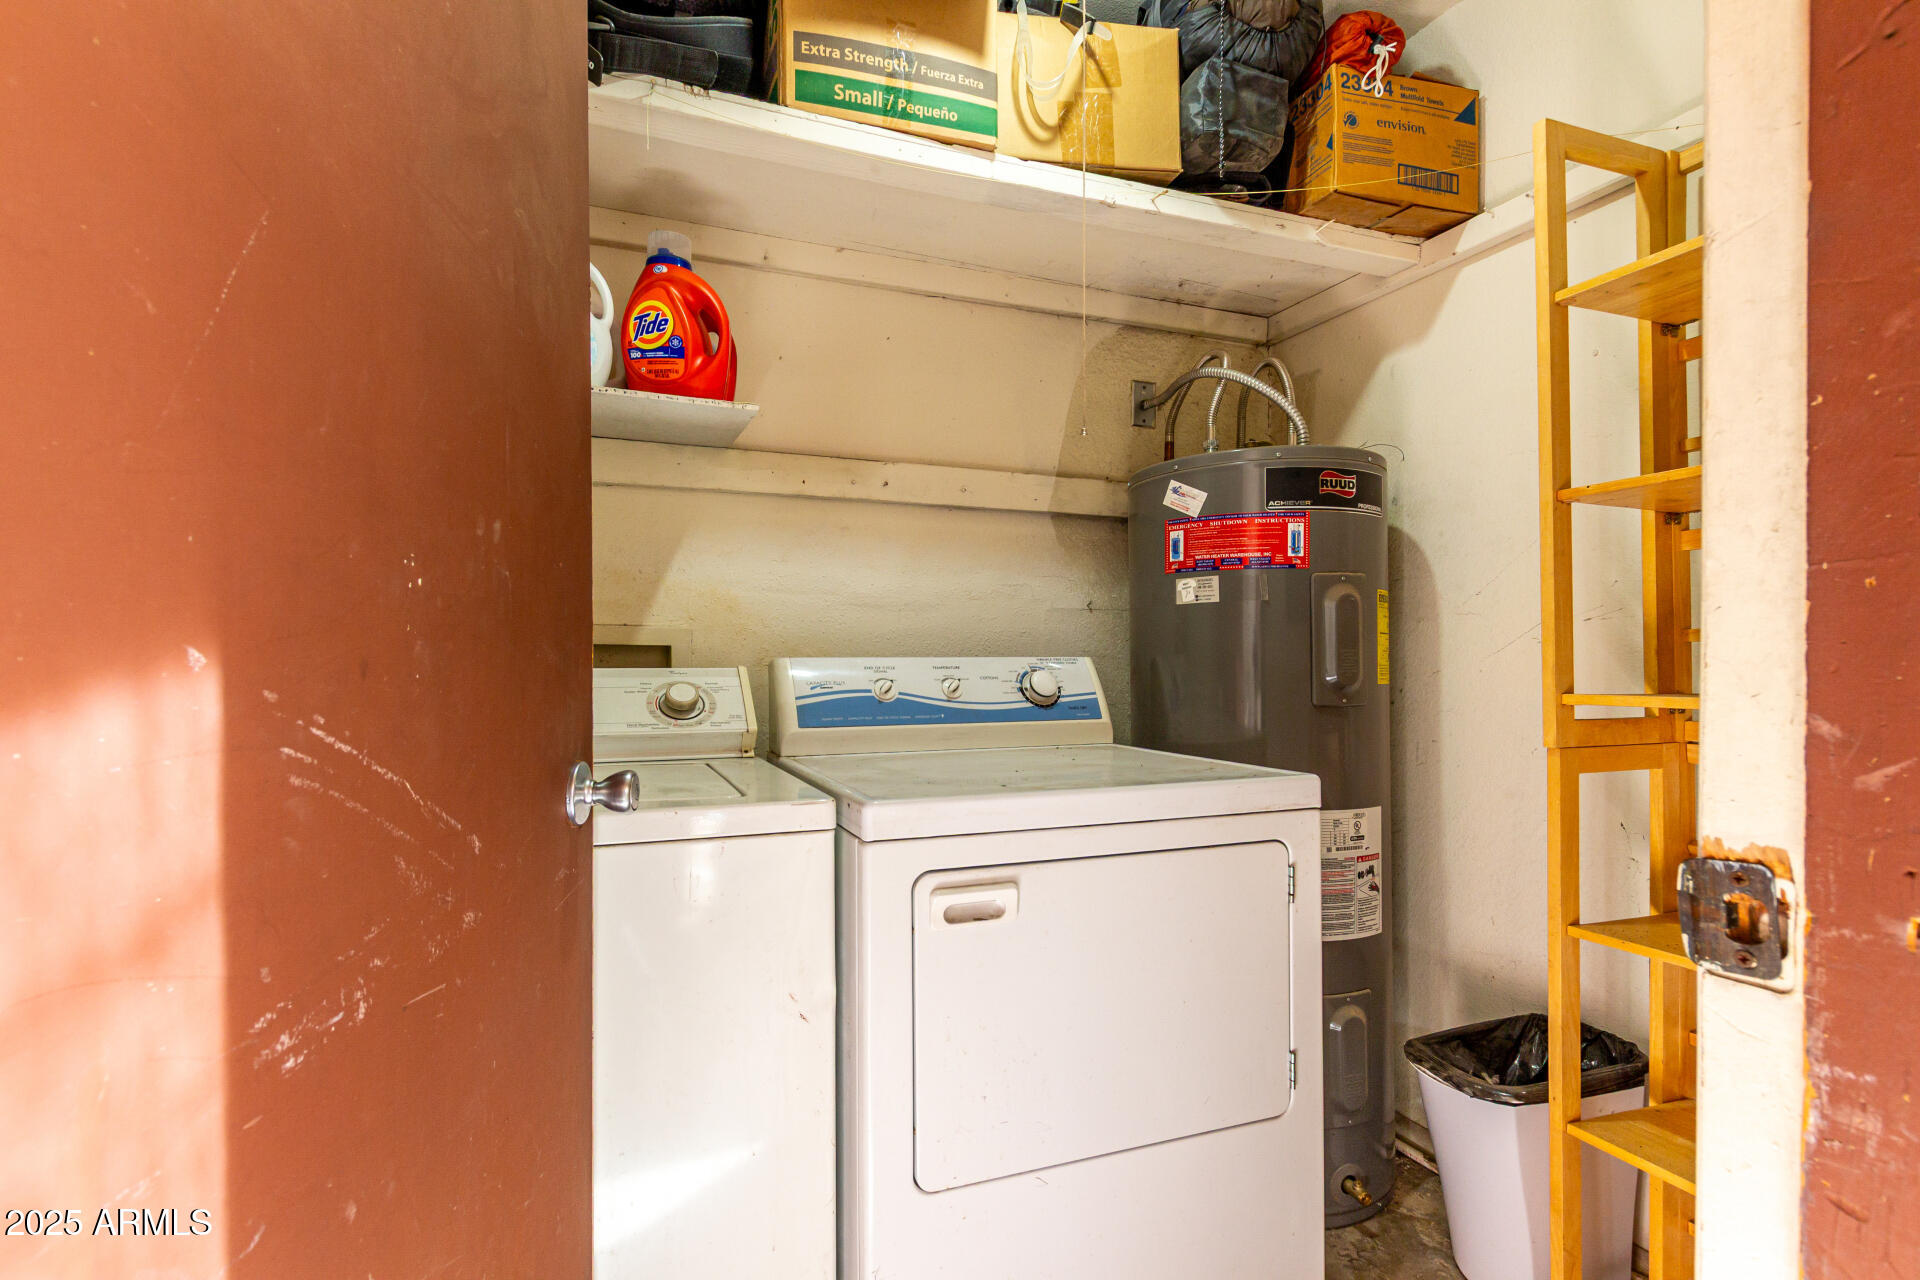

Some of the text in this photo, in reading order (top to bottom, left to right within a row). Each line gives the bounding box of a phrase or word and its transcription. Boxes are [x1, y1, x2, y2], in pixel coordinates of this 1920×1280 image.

[801, 40, 984, 89] Extra Strength / Fuerza Extra
[833, 83, 958, 122] Small / Pequeño
[1376, 117, 1425, 134] envision
[632, 311, 670, 343] Tide
[1320, 478, 1356, 490] RUUD
[1168, 522, 1204, 531] EMERGENCY
[1209, 519, 1248, 527] SHUTDOWN
[1255, 517, 1305, 525] INSTRUCTIONS
